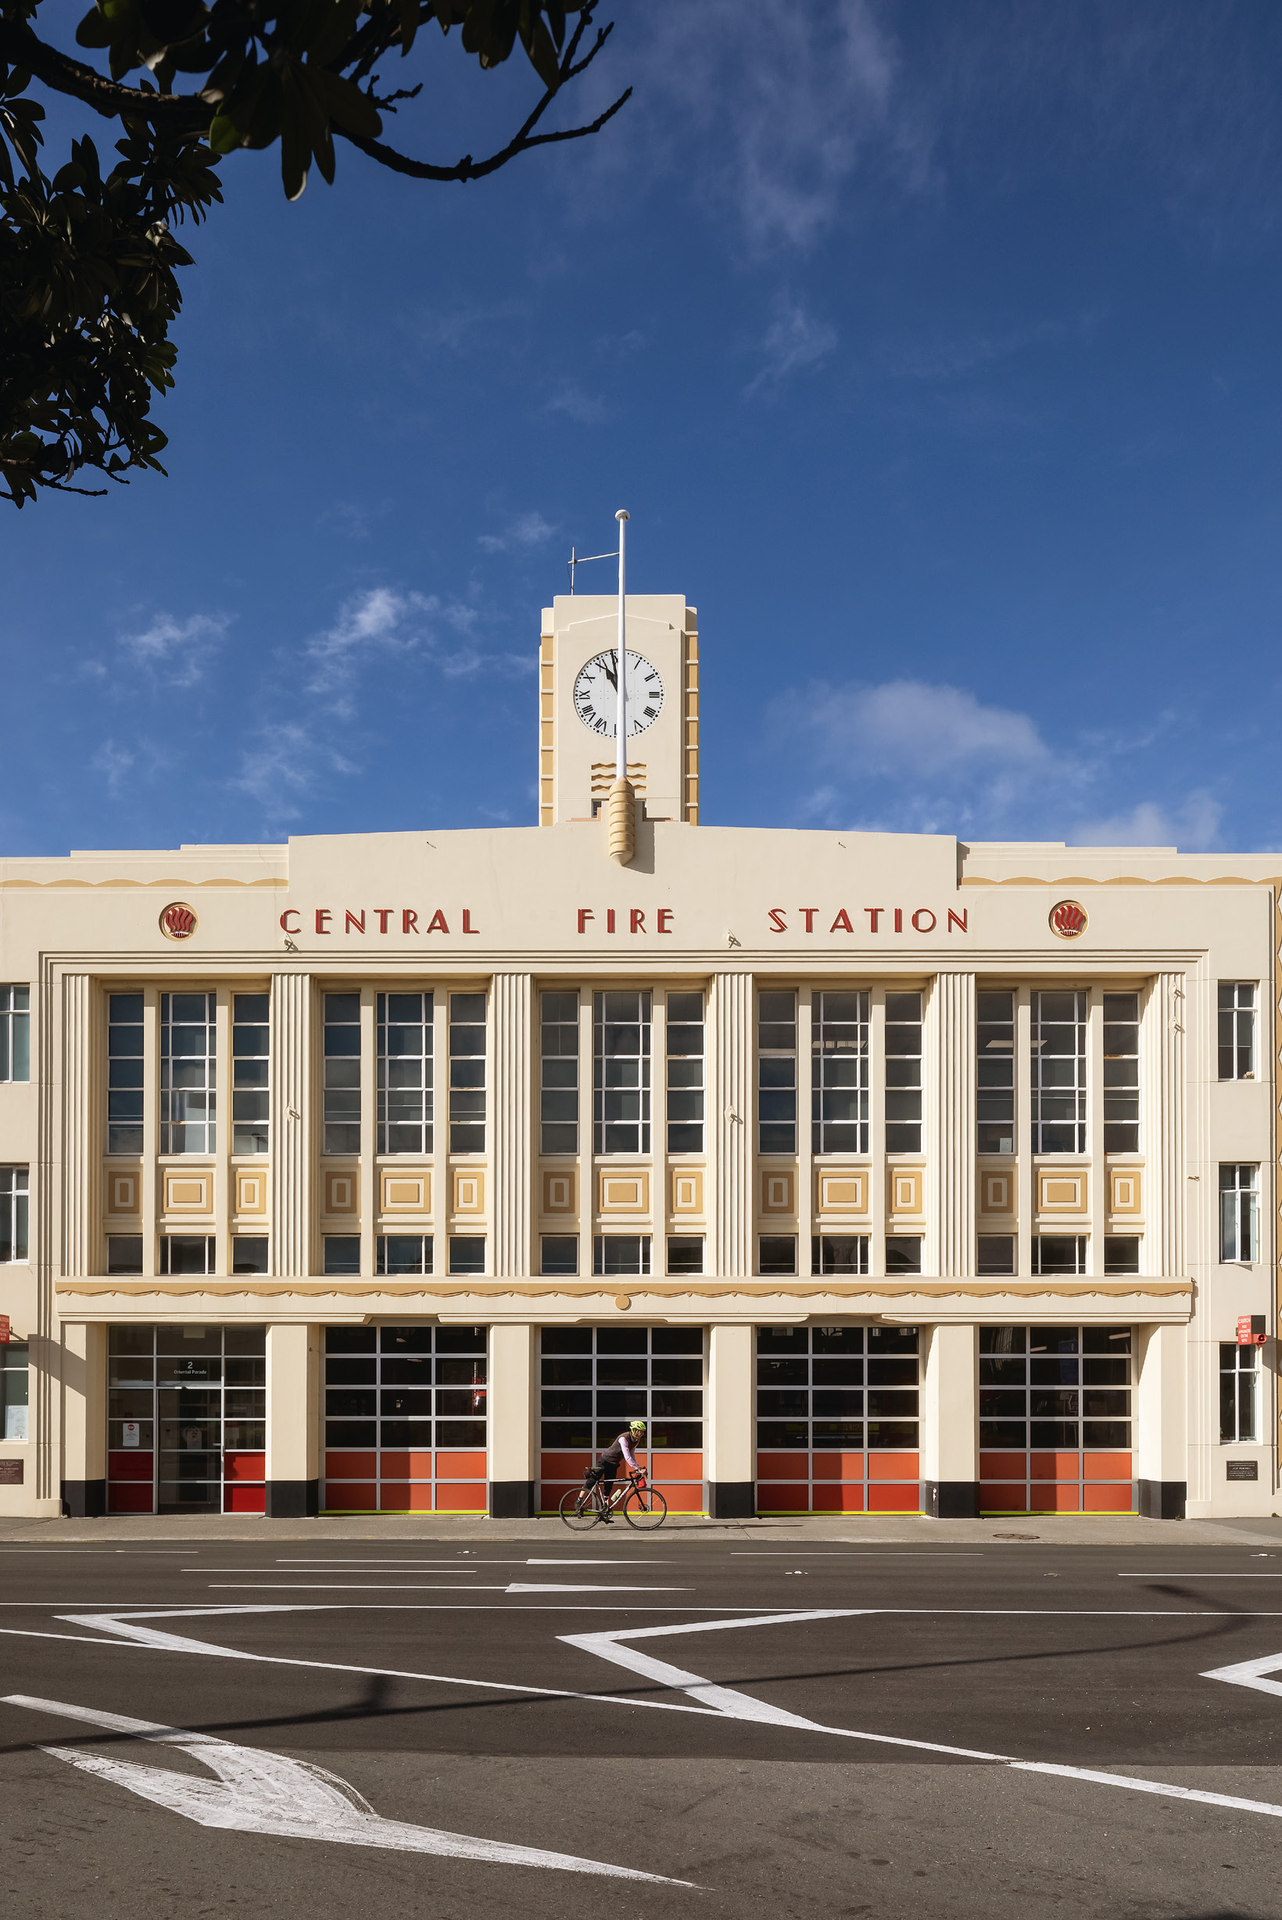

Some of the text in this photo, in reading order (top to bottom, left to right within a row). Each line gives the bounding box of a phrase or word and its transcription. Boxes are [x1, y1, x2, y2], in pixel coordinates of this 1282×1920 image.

[583, 672, 595, 684] X
[644, 673, 655, 682] II
[579, 690, 590, 700] IX
[634, 719, 644, 732] V
[279, 908, 968, 934] CENTRAL FIRE STATION
[187, 1361, 193, 1370] 2
